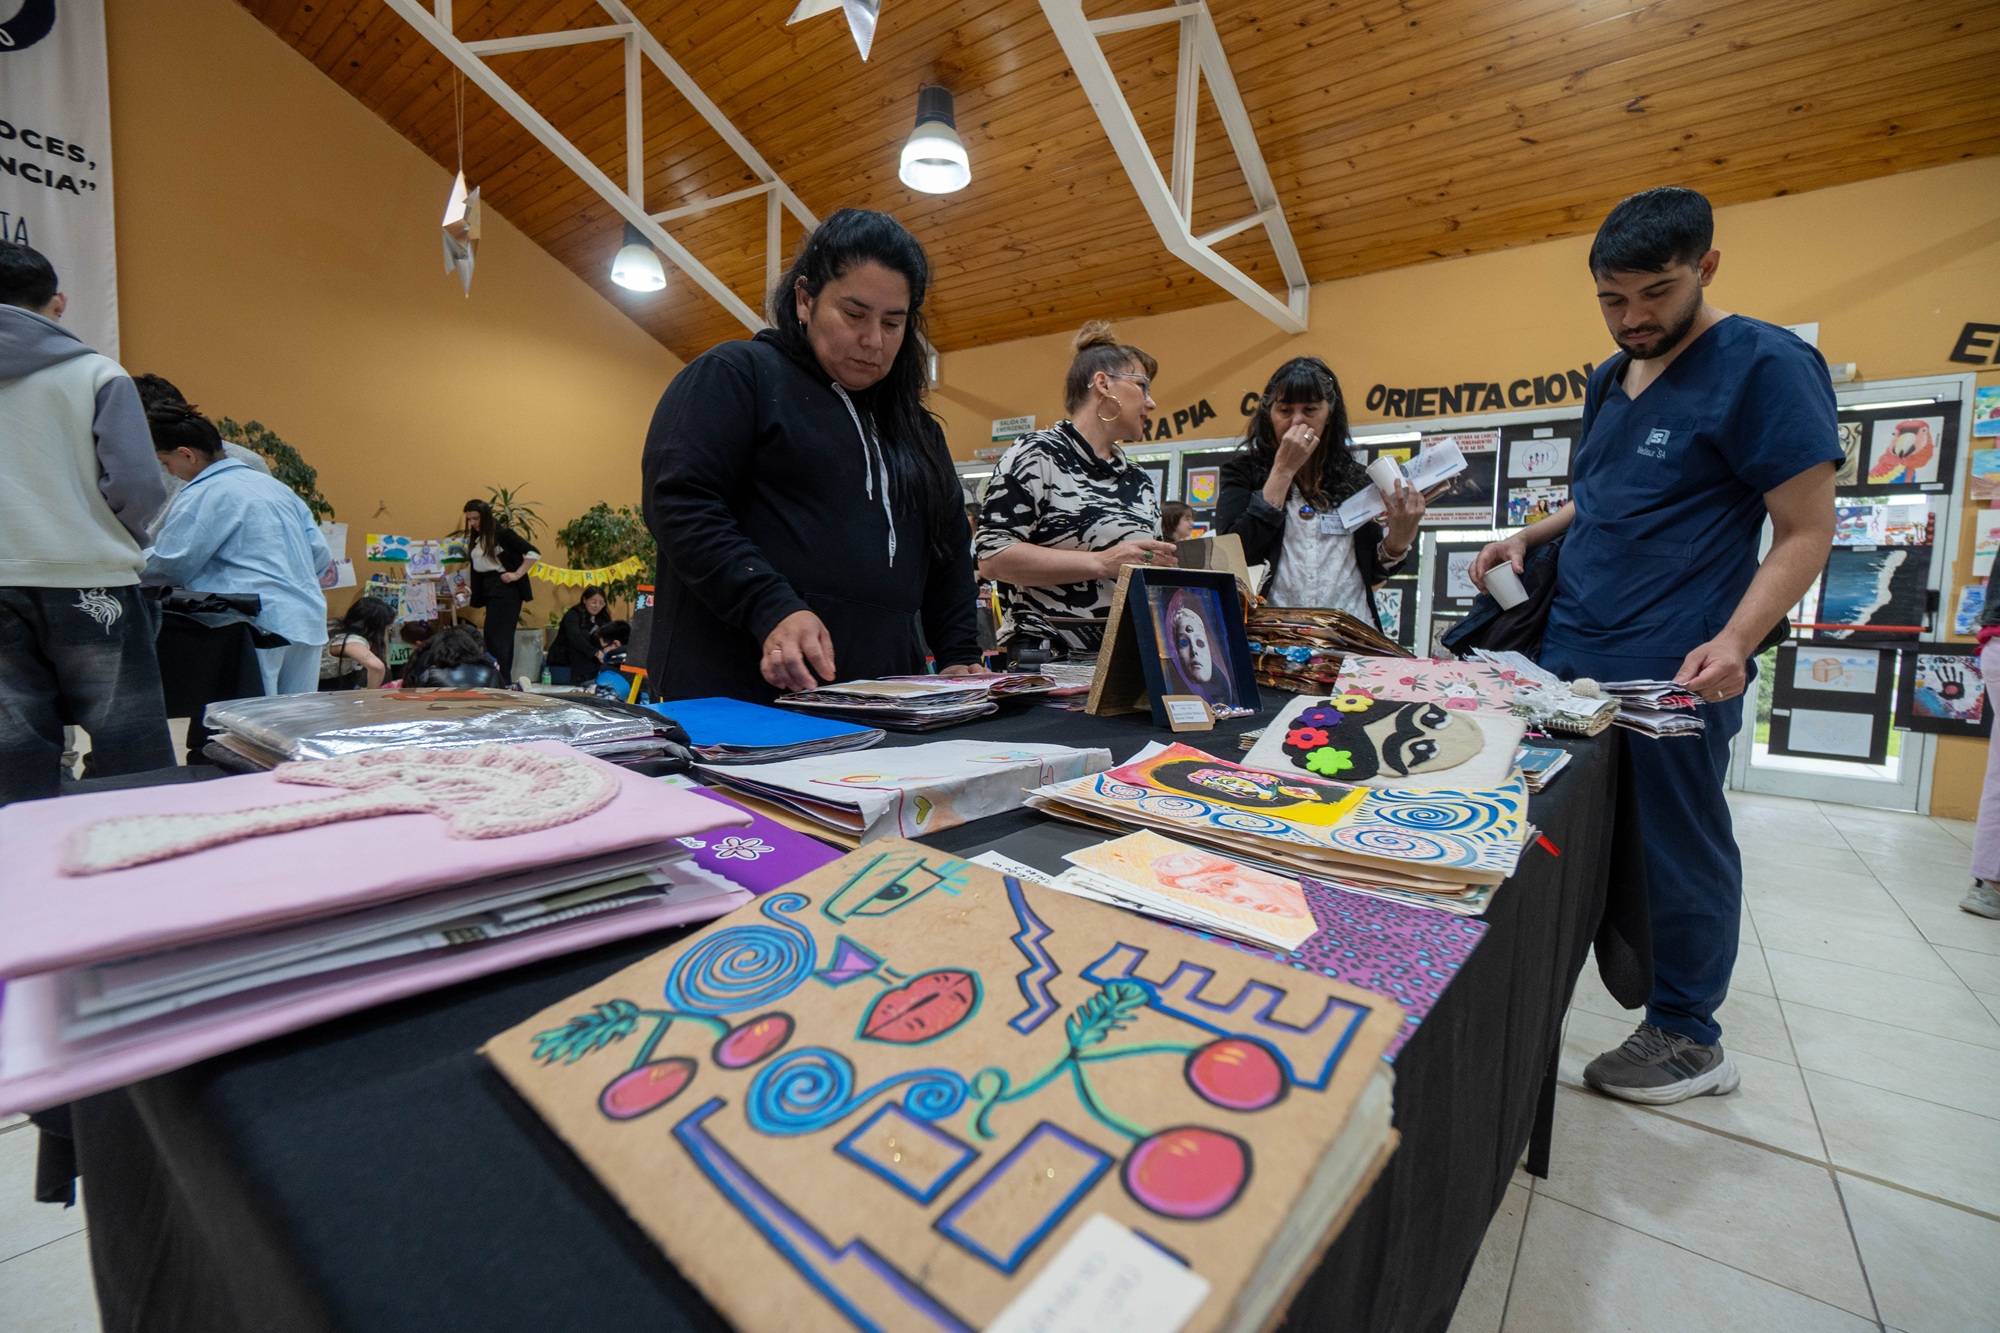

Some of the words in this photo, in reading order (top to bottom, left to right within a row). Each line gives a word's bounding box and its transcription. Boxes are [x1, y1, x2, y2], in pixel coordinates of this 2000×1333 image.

[1123, 399, 1217, 443] RAPIA
[1366, 362, 1595, 419] ORIENTACION
[996, 424, 1031, 433] EMERGENCIA
